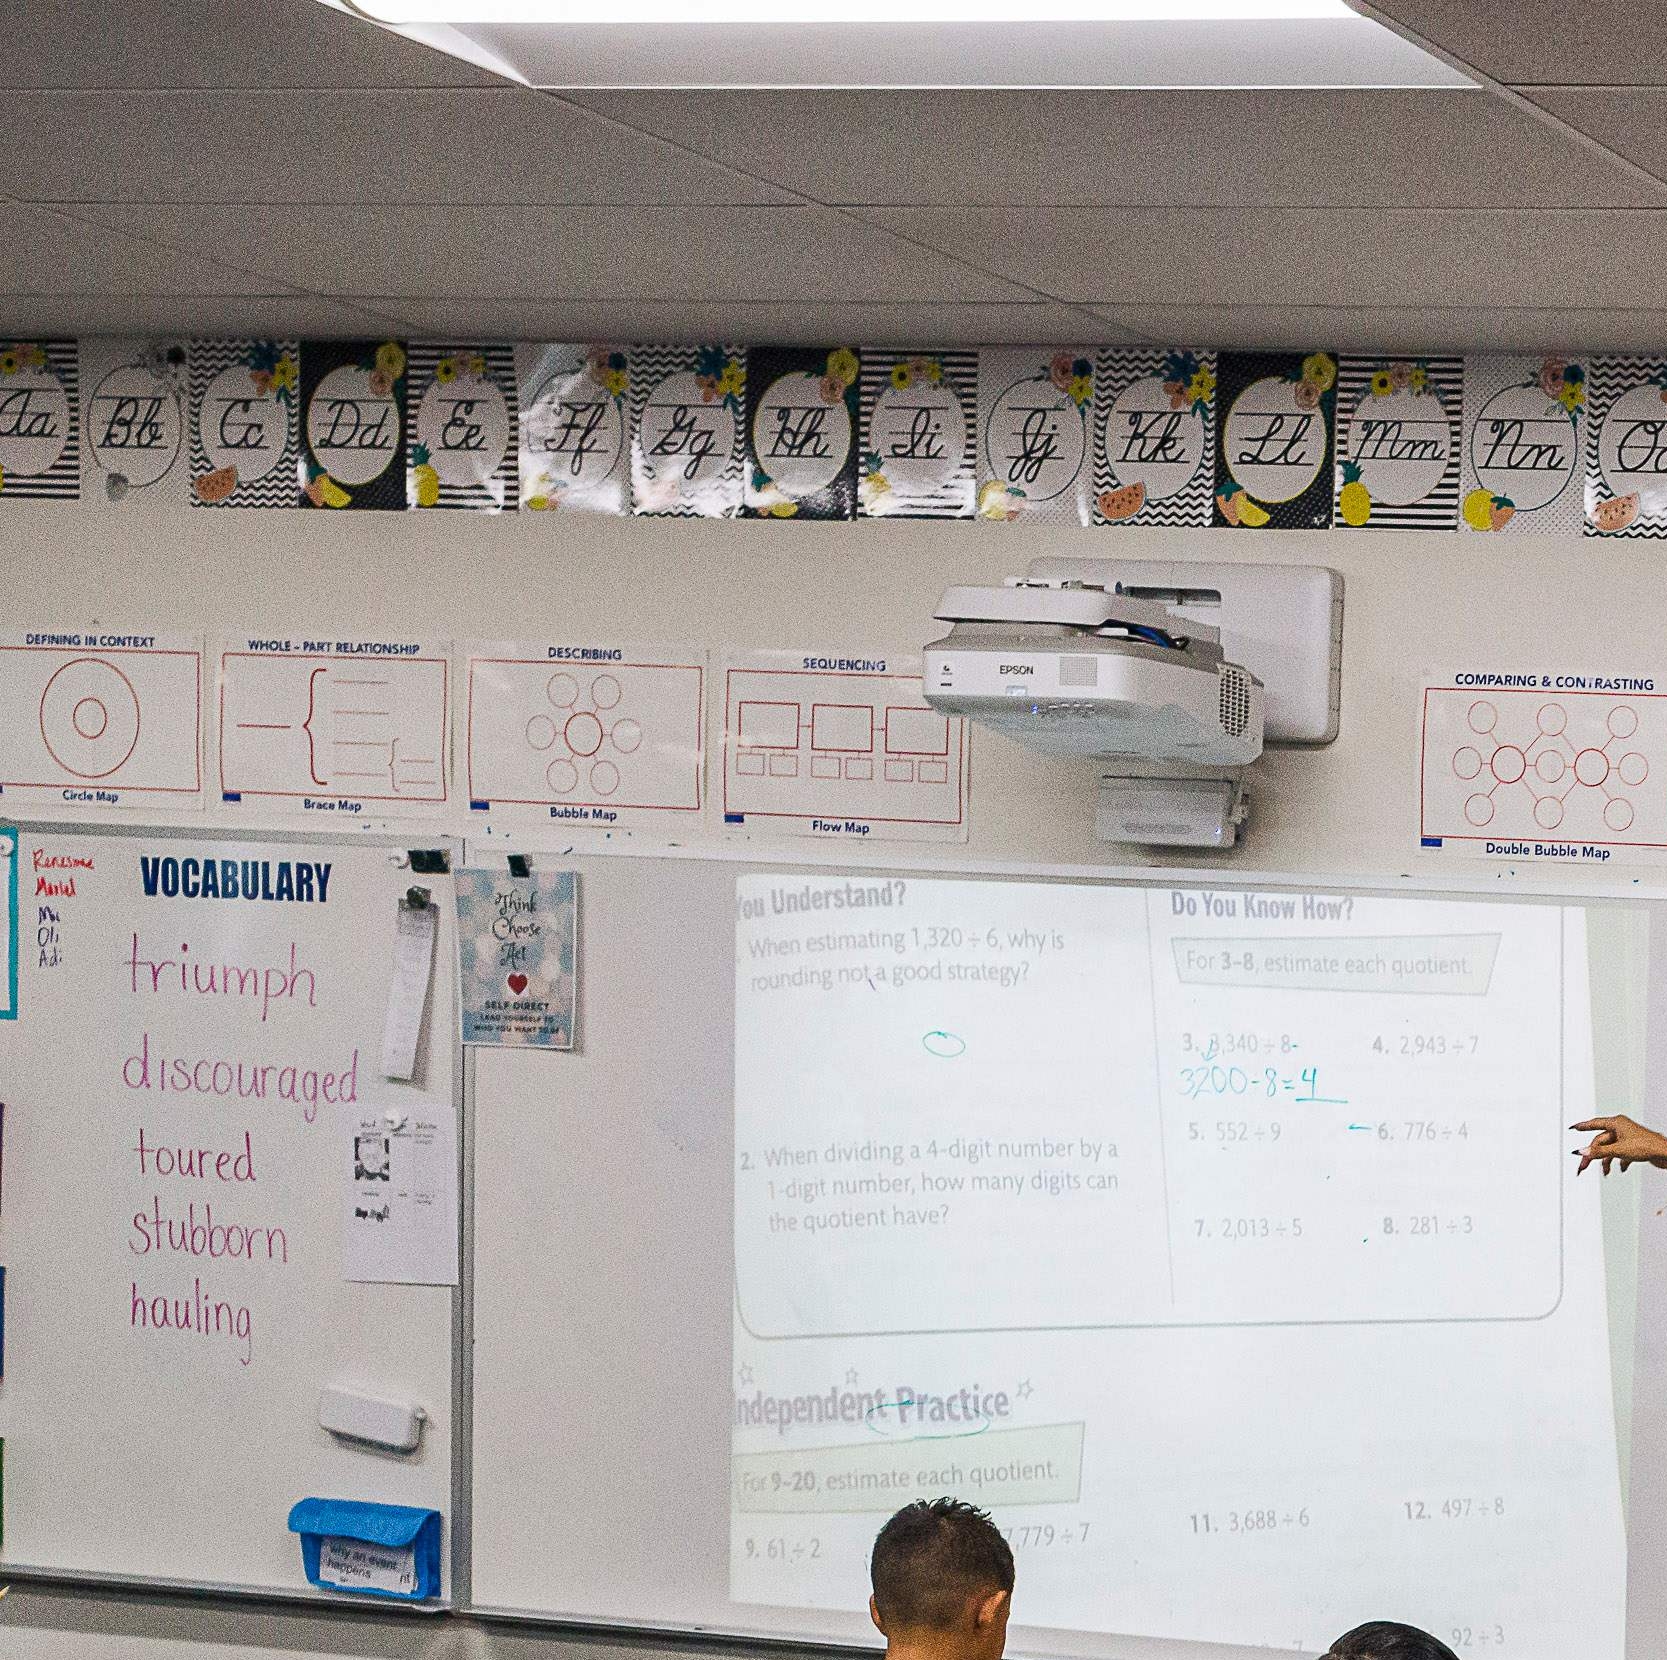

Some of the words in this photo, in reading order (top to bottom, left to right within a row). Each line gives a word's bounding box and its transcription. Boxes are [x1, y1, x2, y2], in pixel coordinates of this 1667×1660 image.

[25, 632, 82, 648] DEFINING
[85, 635, 96, 648] IN
[98, 635, 156, 650] CONTEXT
[248, 641, 290, 651] WHOLE
[303, 641, 331, 651] PART
[336, 642, 419, 654] RELATIONSHIP
[545, 647, 622, 663] DESCRIBING
[800, 658, 888, 676] SEQUENCING
[1000, 665, 1033, 675] EPSON
[1455, 674, 1536, 686] COMPARING
[1542, 676, 1551, 687] &
[1556, 677, 1654, 690] CONTRASTING
[63, 790, 93, 800] Circle
[96, 791, 118, 803] Map
[813, 821, 841, 832] Flow
[845, 822, 869, 835] Map
[1486, 842, 1530, 855] Double
[1535, 844, 1577, 857] Bubble
[1582, 846, 1610, 861] Map
[141, 857, 331, 902] VOCABULARY
[771, 880, 907, 914] Understand?
[1172, 891, 1198, 917] Do
[1201, 893, 1238, 918] You
[1242, 894, 1297, 919] Know
[1301, 896, 1355, 921] How?
[749, 933, 800, 963] When
[806, 931, 905, 954] estimating
[1008, 928, 1046, 954] why
[1052, 930, 1064, 950] is
[122, 932, 317, 1021] triumph
[752, 969, 833, 991] rounding
[838, 962, 870, 983] not
[892, 960, 943, 988] good
[947, 961, 1030, 988] strategy?
[122, 1033, 359, 1124] discouraged
[132, 1127, 257, 1183] toured
[764, 1147, 817, 1167] When
[825, 1141, 904, 1166] dividing
[910, 1145, 920, 1159] a
[927, 1138, 991, 1164] 4-digit
[998, 1138, 1074, 1157] number
[1080, 1138, 1102, 1162] by
[1108, 1143, 1118, 1157] a
[127, 1194, 288, 1263] stubborn
[130, 1277, 253, 1366] hauling
[894, 1384, 1008, 1423] Practice
